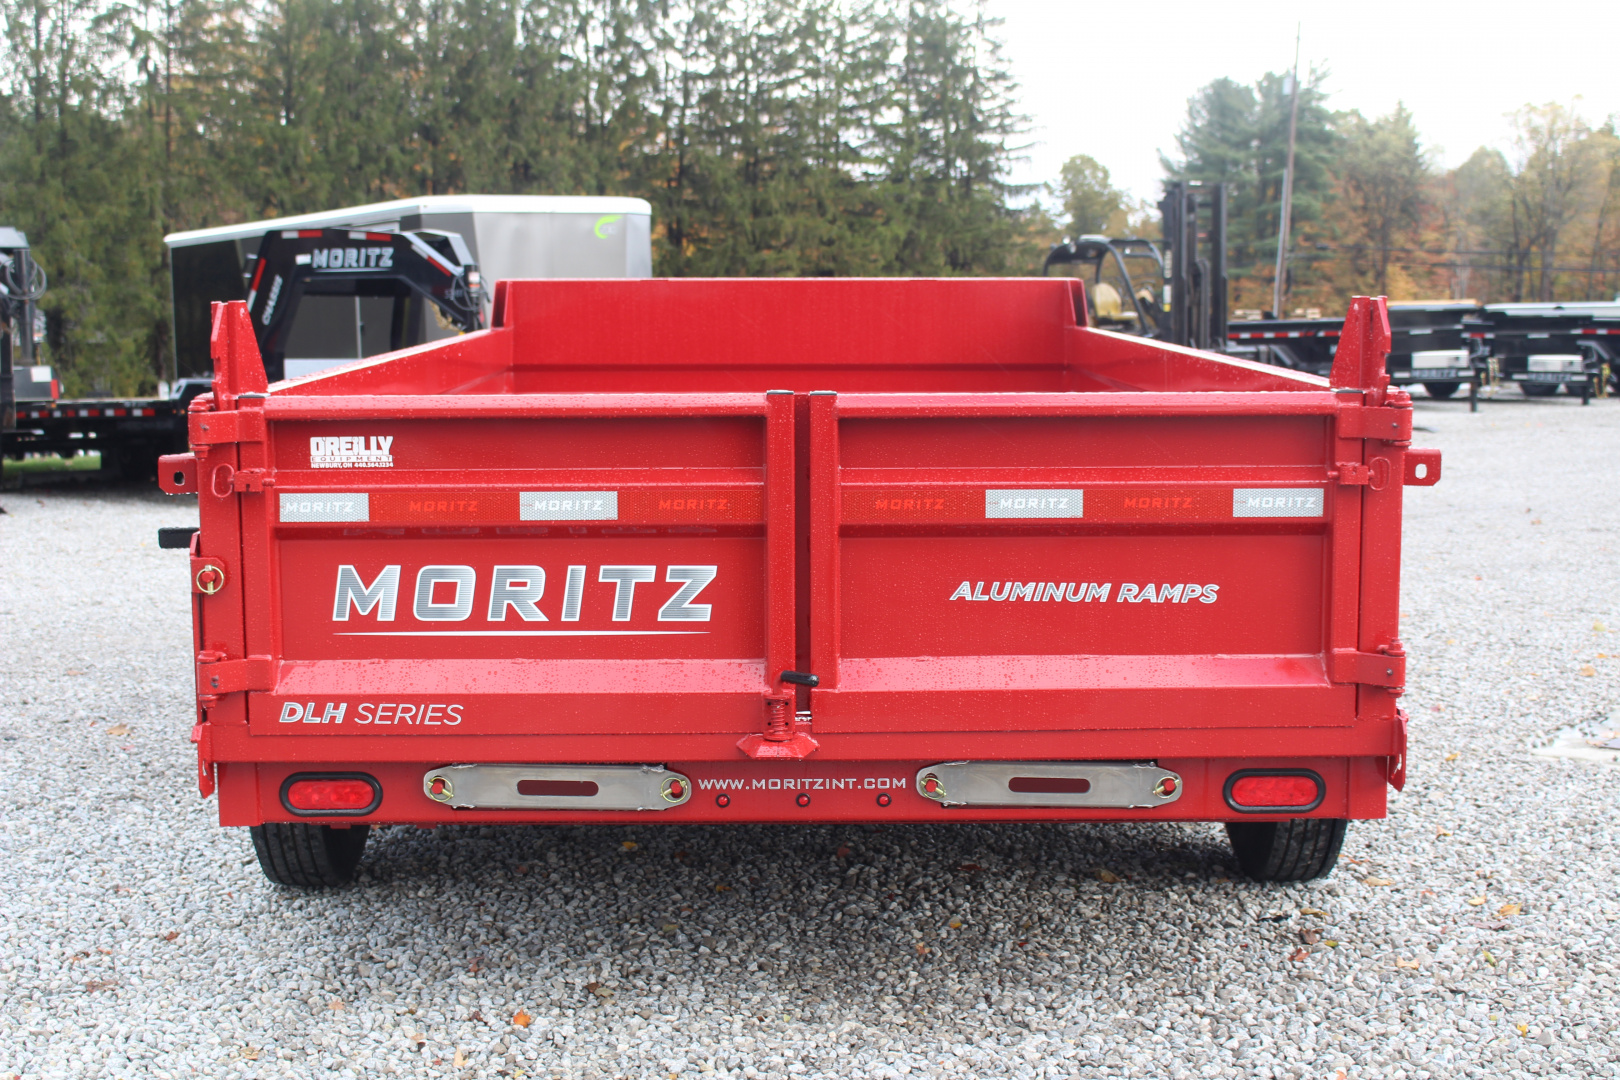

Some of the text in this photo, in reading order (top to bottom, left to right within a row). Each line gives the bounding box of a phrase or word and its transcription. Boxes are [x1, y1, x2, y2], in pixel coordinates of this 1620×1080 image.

[312, 247, 394, 268] MORITZ
[285, 501, 354, 514] MORITZ
[409, 501, 478, 512] MORITZ
[534, 500, 603, 511] MORITZ
[658, 499, 728, 510] MORITZ
[876, 499, 945, 510] MORITZ
[1000, 498, 1069, 510] MORITZ
[1124, 497, 1193, 508] MORITZ
[1247, 497, 1317, 508] MORITZ
[332, 565, 718, 622] MORITZ
[949, 581, 1220, 604] ALUMINUM RAMPS
[279, 702, 464, 726] DLH SERIES
[698, 778, 906, 790] WWW.MORITZINT.COM
